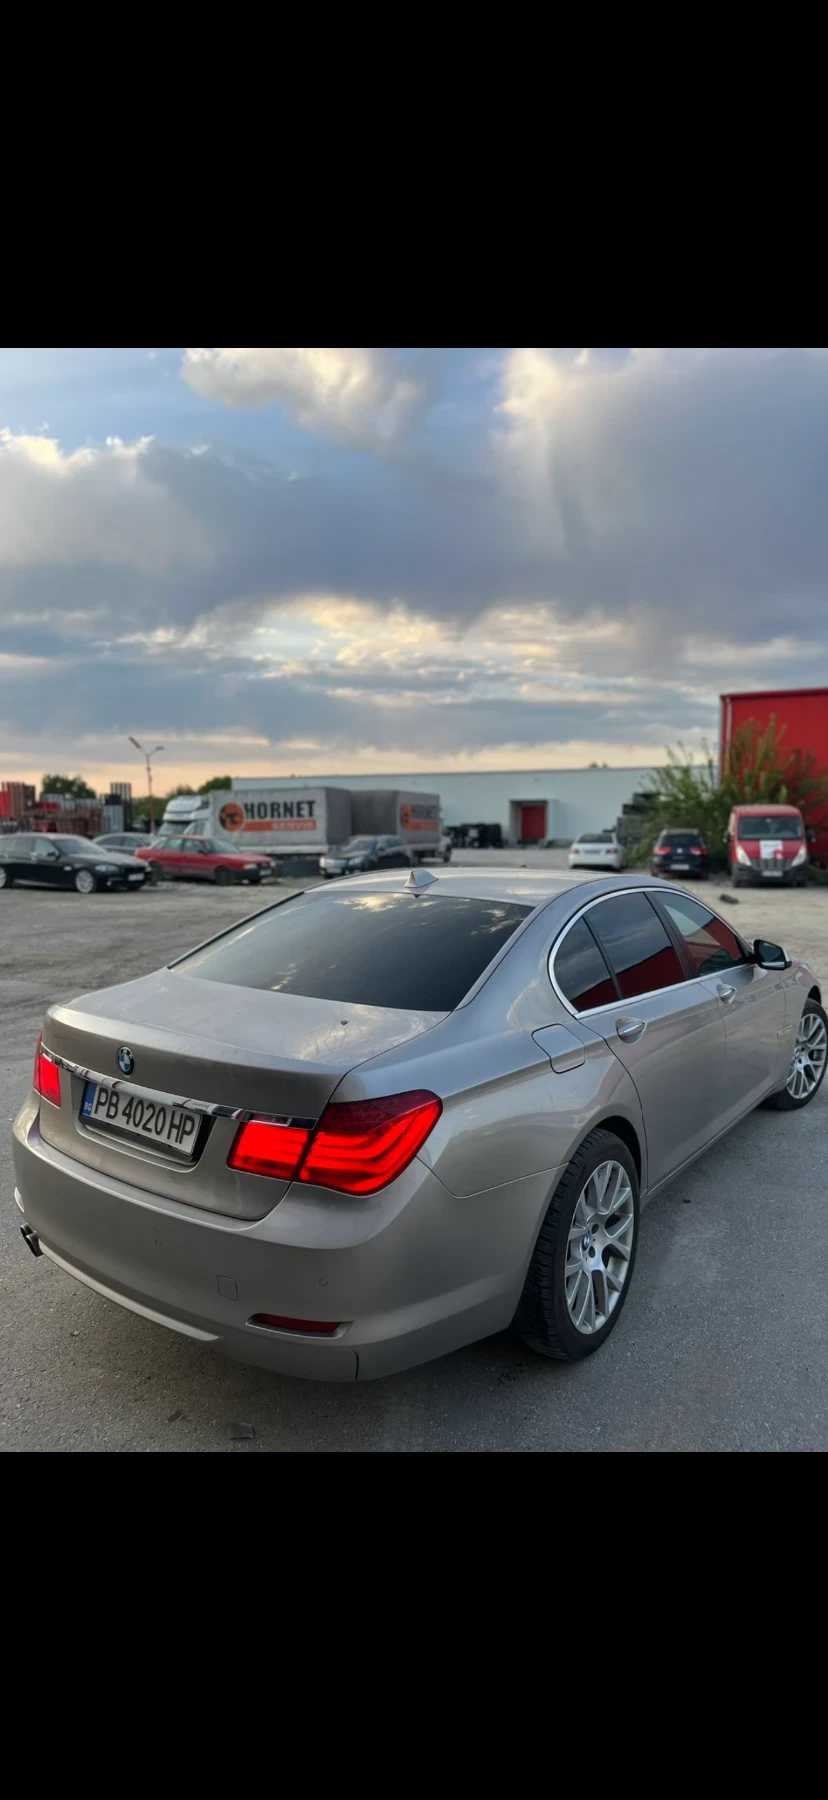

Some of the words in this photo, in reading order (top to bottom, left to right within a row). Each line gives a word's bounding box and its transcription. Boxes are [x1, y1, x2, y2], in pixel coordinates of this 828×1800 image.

[244, 800, 316, 819] HORNET
[93, 1087, 119, 1119] PB
[122, 1096, 167, 1136] 4020
[167, 1110, 195, 1144] HP
